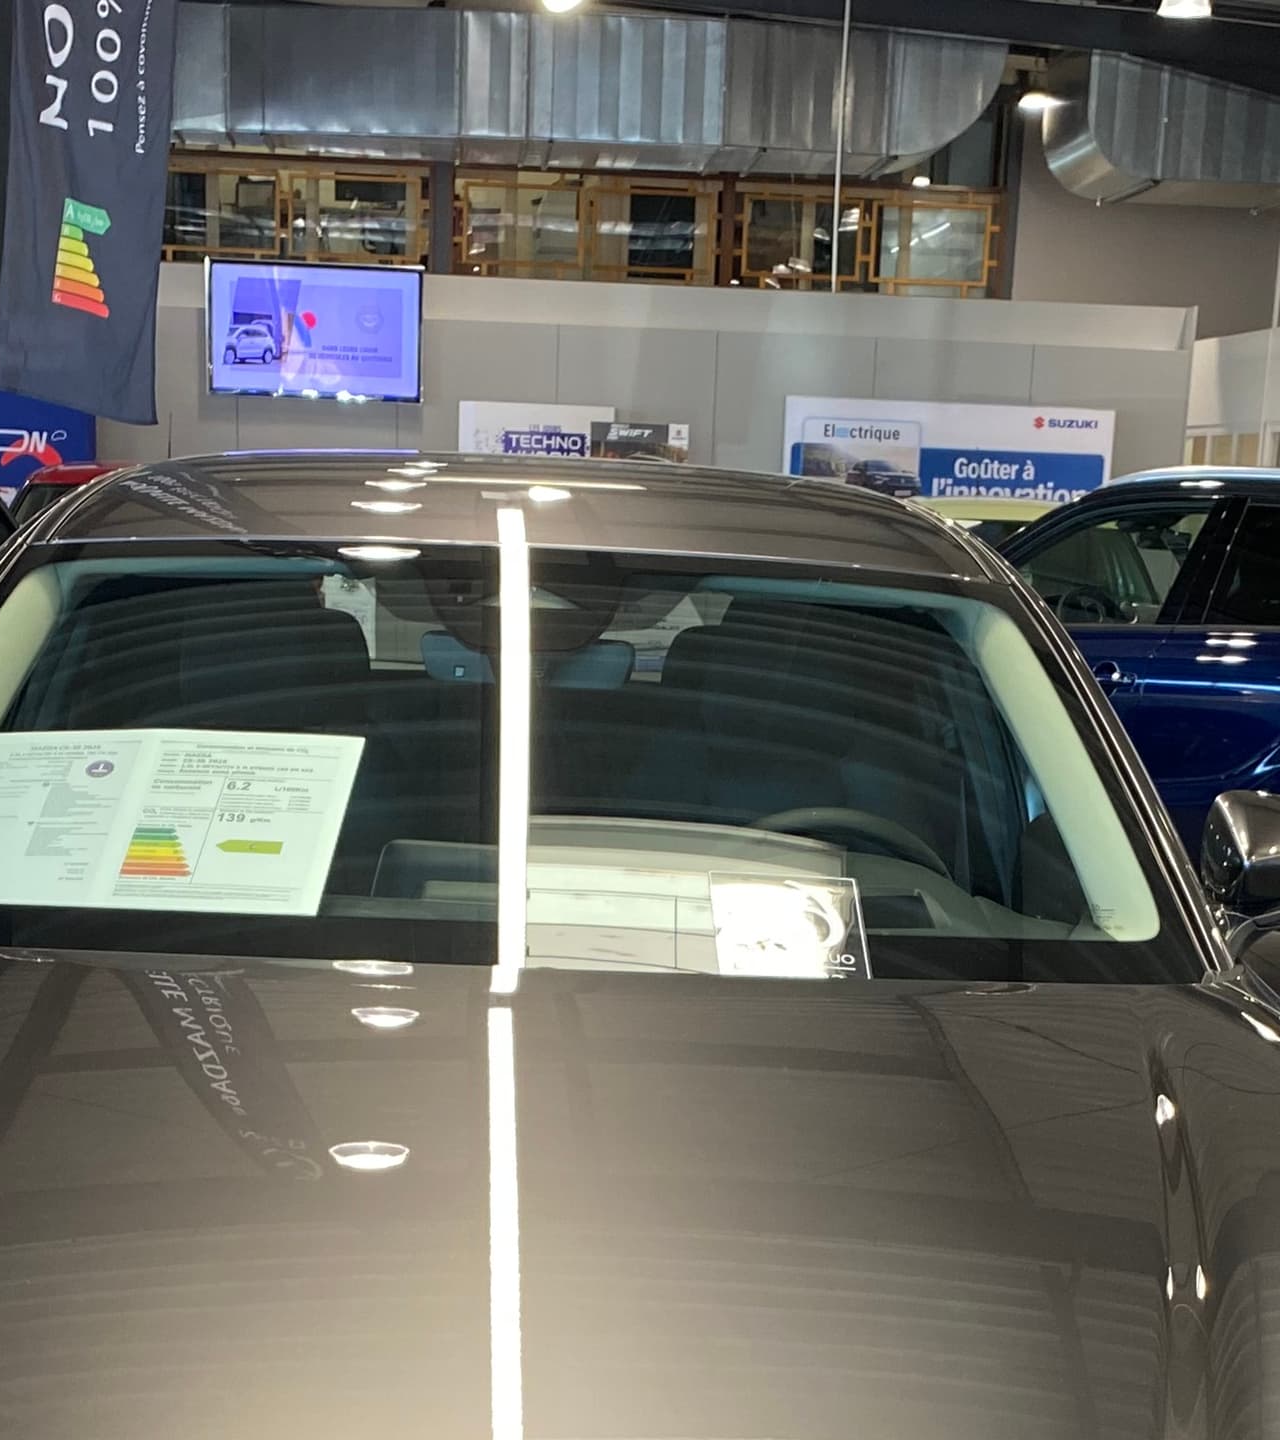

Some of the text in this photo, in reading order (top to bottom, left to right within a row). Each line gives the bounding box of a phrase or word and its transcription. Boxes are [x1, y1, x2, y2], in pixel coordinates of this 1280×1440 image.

[134, 95, 147, 154] Pensez
[1047, 418, 1099, 430] SUZUKI
[609, 427, 653, 439] SWIFT
[508, 434, 582, 450] TECHNO
[953, 456, 1037, 481] Goûter à
[226, 781, 252, 792] 6.2
[217, 812, 247, 824] 139
